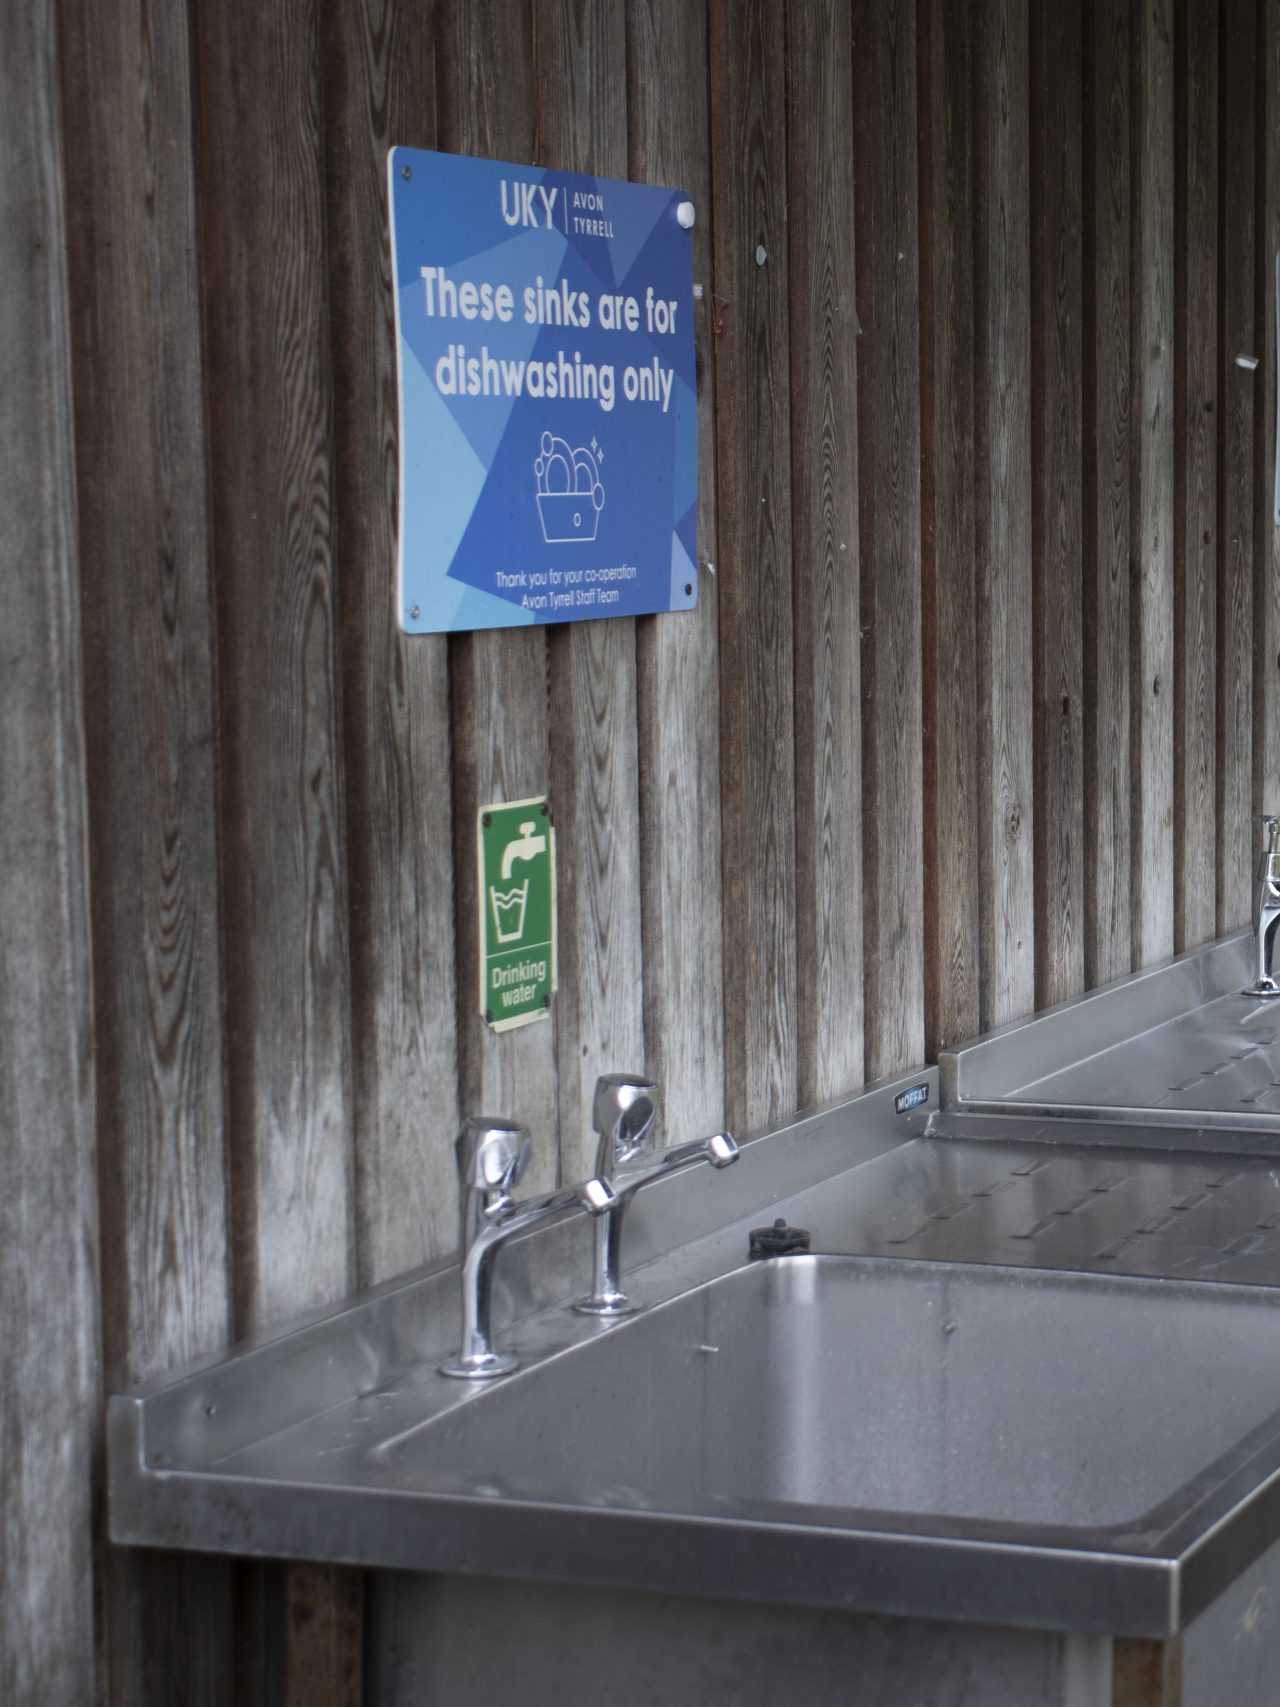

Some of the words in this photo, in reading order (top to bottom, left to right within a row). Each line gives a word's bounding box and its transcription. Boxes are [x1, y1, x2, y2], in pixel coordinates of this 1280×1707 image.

[501, 179, 558, 229] UKY
[573, 191, 603, 212] AVON
[573, 217, 615, 239] TYRRELL
[420, 266, 514, 322] These
[523, 275, 590, 328] sinks
[598, 292, 640, 332] are
[645, 287, 678, 334] for
[435, 344, 615, 411] dishwashing
[623, 356, 674, 412] only
[496, 571, 527, 588] Thank
[529, 573, 547, 589] you
[549, 569, 562, 585] for
[564, 570, 583, 587] your
[585, 564, 636, 584] co-operation
[521, 594, 547, 609] Avon
[549, 591, 574, 610] Tyrrell
[576, 589, 595, 606] Staff
[597, 588, 619, 604] Team
[492, 959, 546, 988] Drinking
[502, 984, 537, 1007] water
[898, 1086, 927, 1111] MOFFAT
